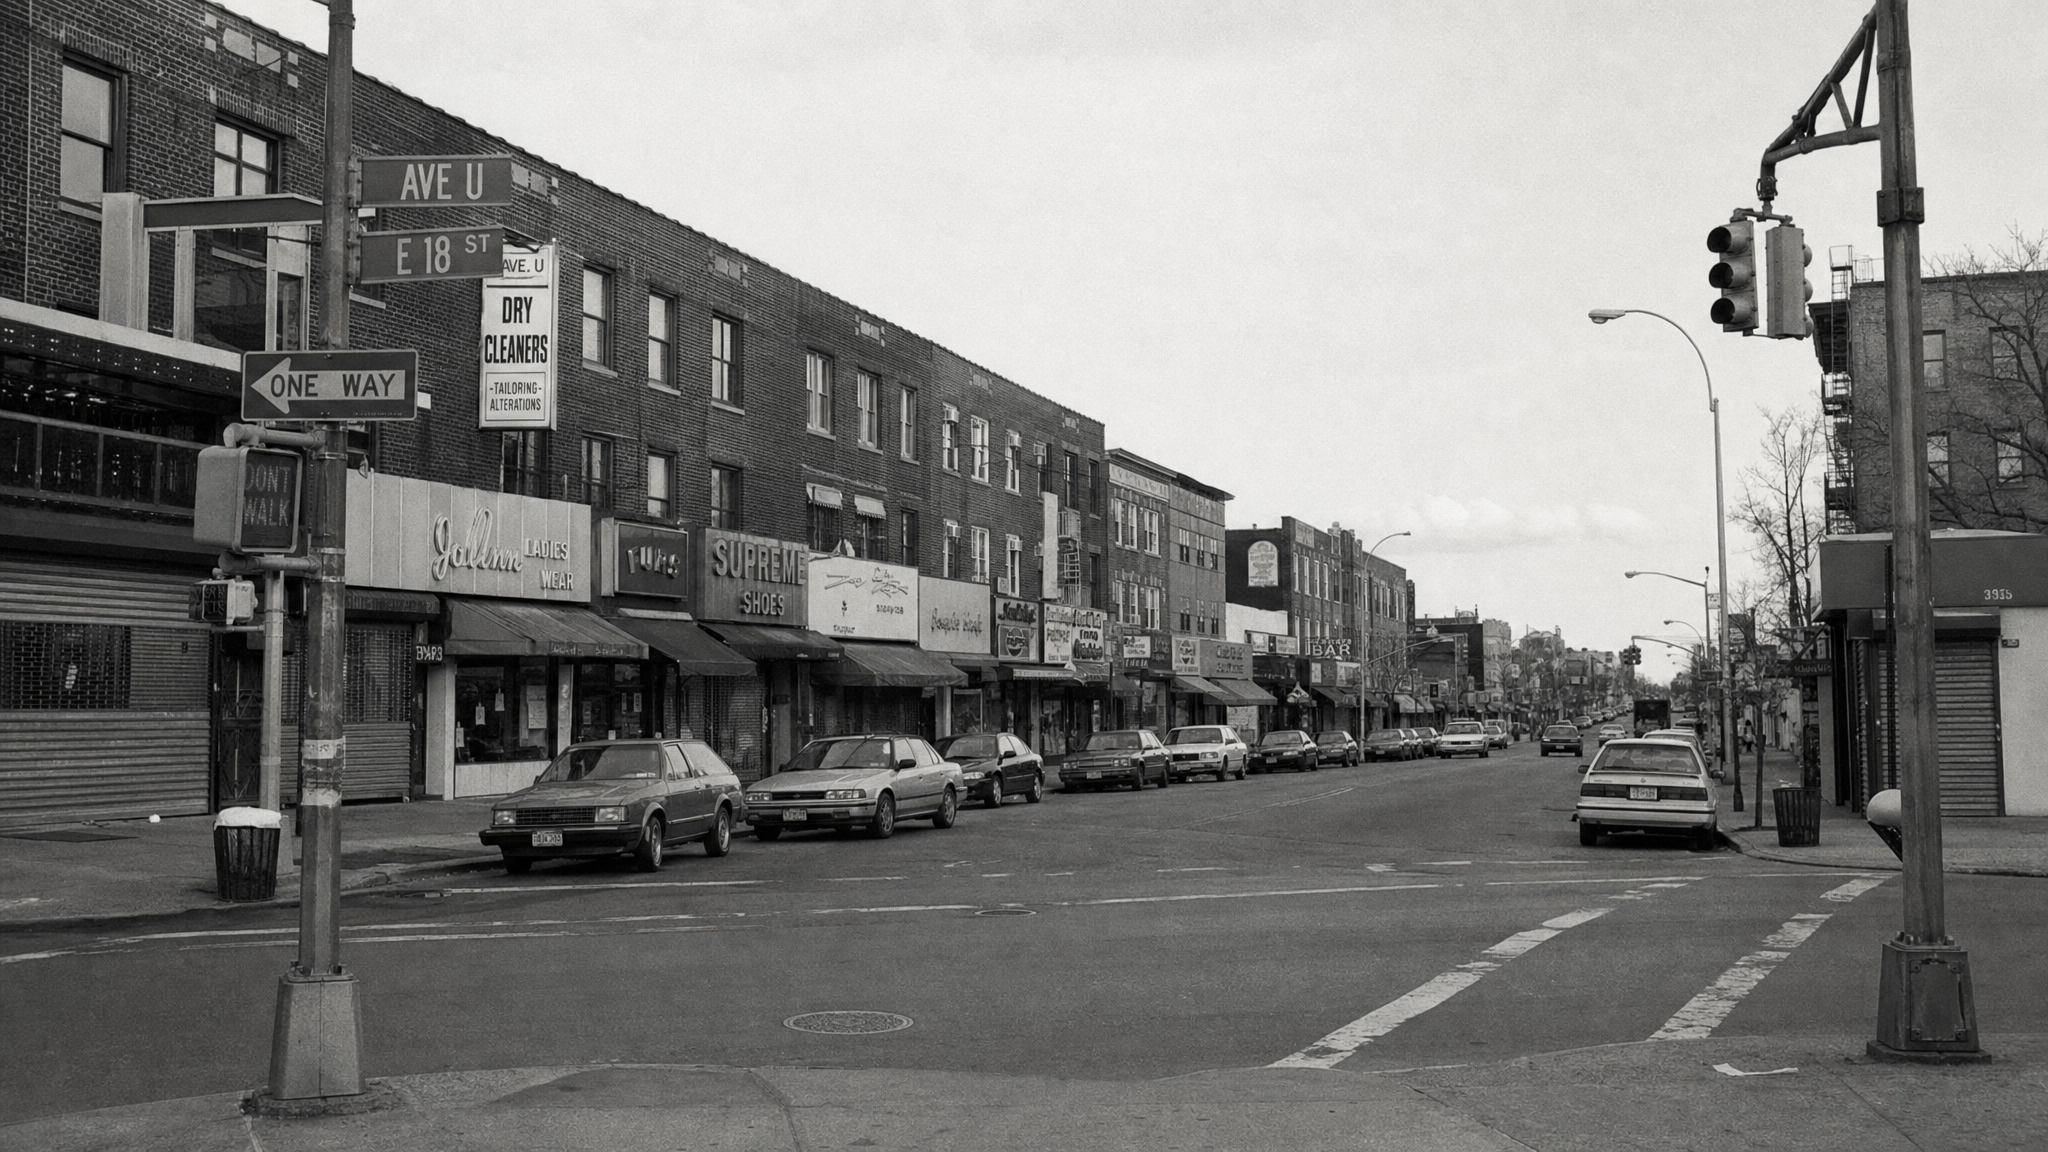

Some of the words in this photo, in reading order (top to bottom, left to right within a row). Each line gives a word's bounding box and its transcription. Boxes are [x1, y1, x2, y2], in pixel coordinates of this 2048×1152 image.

[400, 163, 452, 200] AVE
[466, 163, 483, 200] U
[397, 238, 412, 275] E
[424, 235, 451, 274] 18
[465, 233, 490, 254] ST
[503, 258, 530, 273] AVE.
[535, 258, 544, 273] U
[502, 296, 533, 324] DRY
[484, 334, 548, 364] CLEANERS
[270, 373, 319, 398] ONE
[342, 372, 396, 397] WAY
[489, 398, 541, 411] ALTERATIONS
[243, 496, 290, 526] WALK
[524, 538, 569, 560] LADIES
[713, 537, 808, 587] SUPREME
[541, 570, 574, 590] WEAR
[742, 591, 785, 616] SHOES
[1312, 643, 1351, 656] BAR
